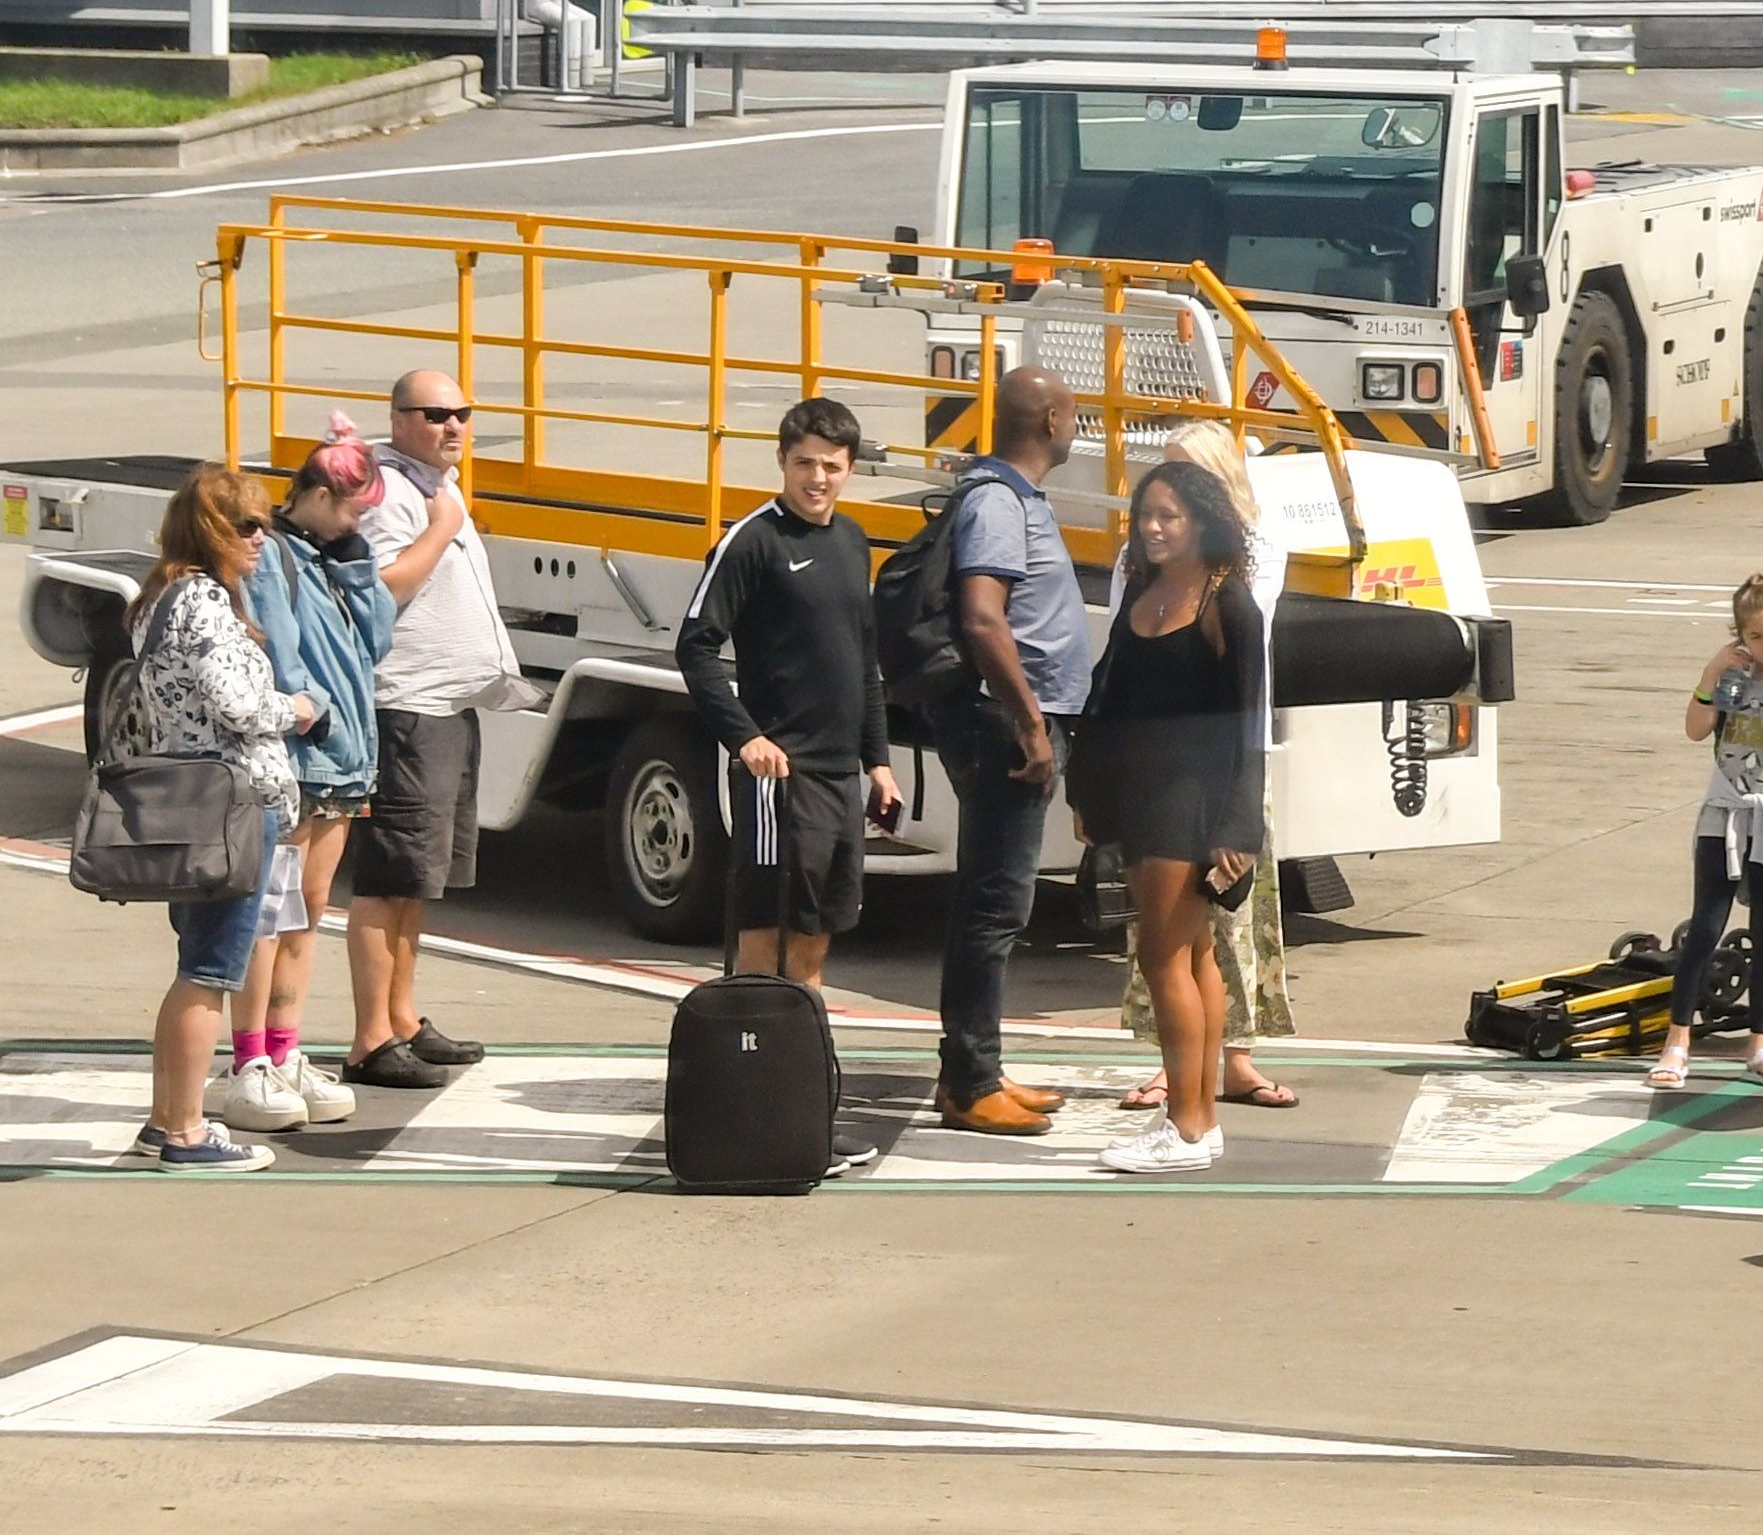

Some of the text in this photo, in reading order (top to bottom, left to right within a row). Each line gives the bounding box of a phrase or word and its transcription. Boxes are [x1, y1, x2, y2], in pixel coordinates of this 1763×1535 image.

[1560, 229, 1570, 304] 8
[1365, 320, 1424, 336] 214-1341
[1361, 565, 1426, 592] HL
[741, 1031, 759, 1052] it
